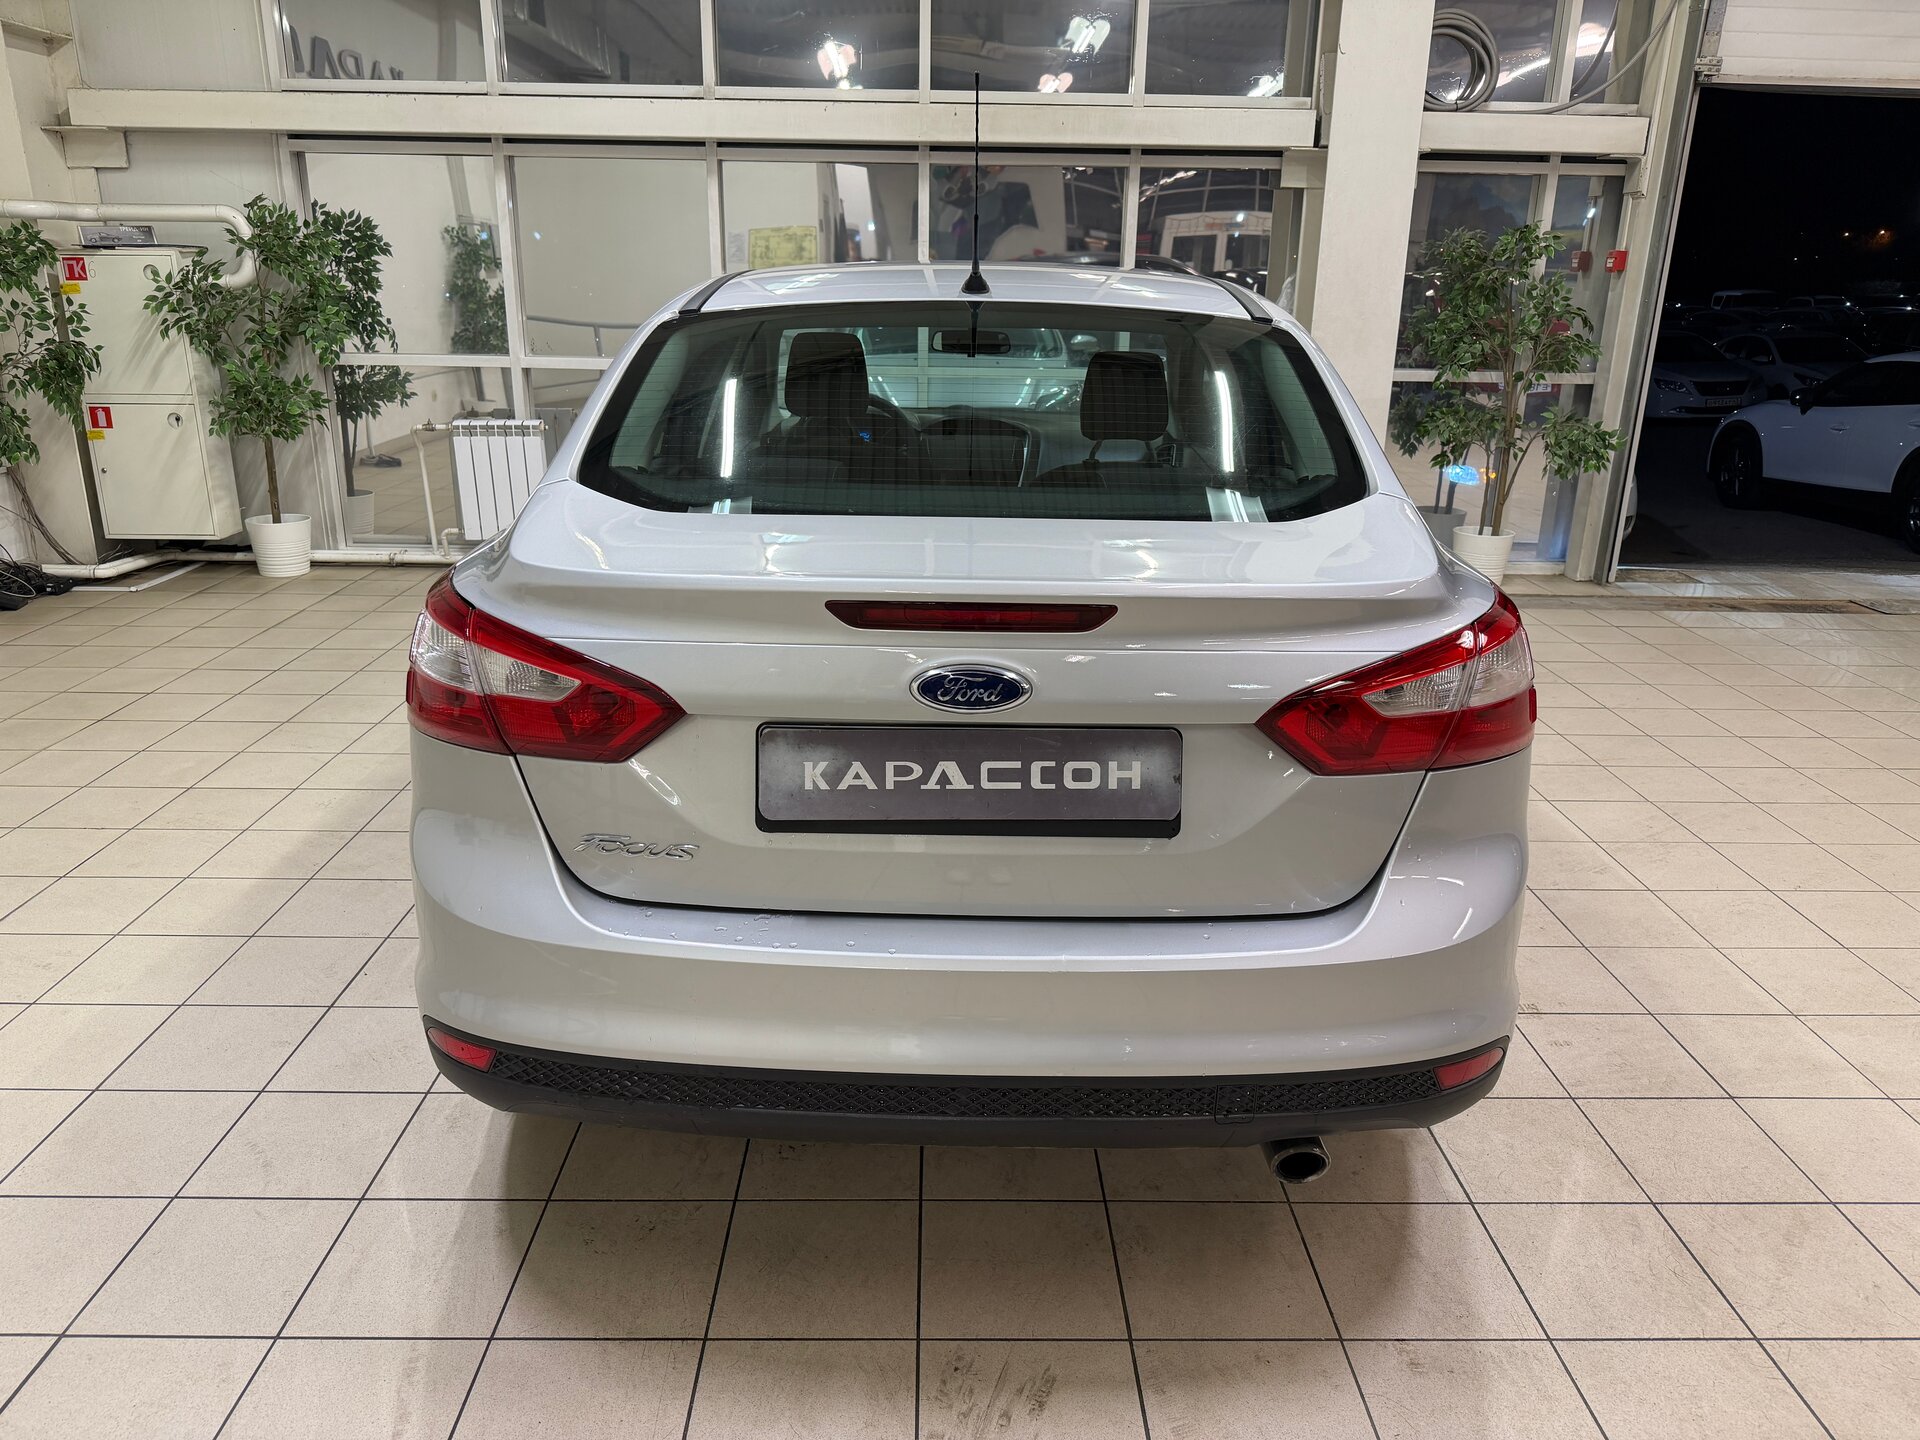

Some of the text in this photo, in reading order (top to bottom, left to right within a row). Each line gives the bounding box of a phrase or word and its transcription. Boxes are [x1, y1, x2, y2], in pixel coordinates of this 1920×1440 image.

[63, 259, 87, 278] ПК
[937, 672, 1004, 702] Ford
[803, 760, 1142, 790] КАРЛССОН
